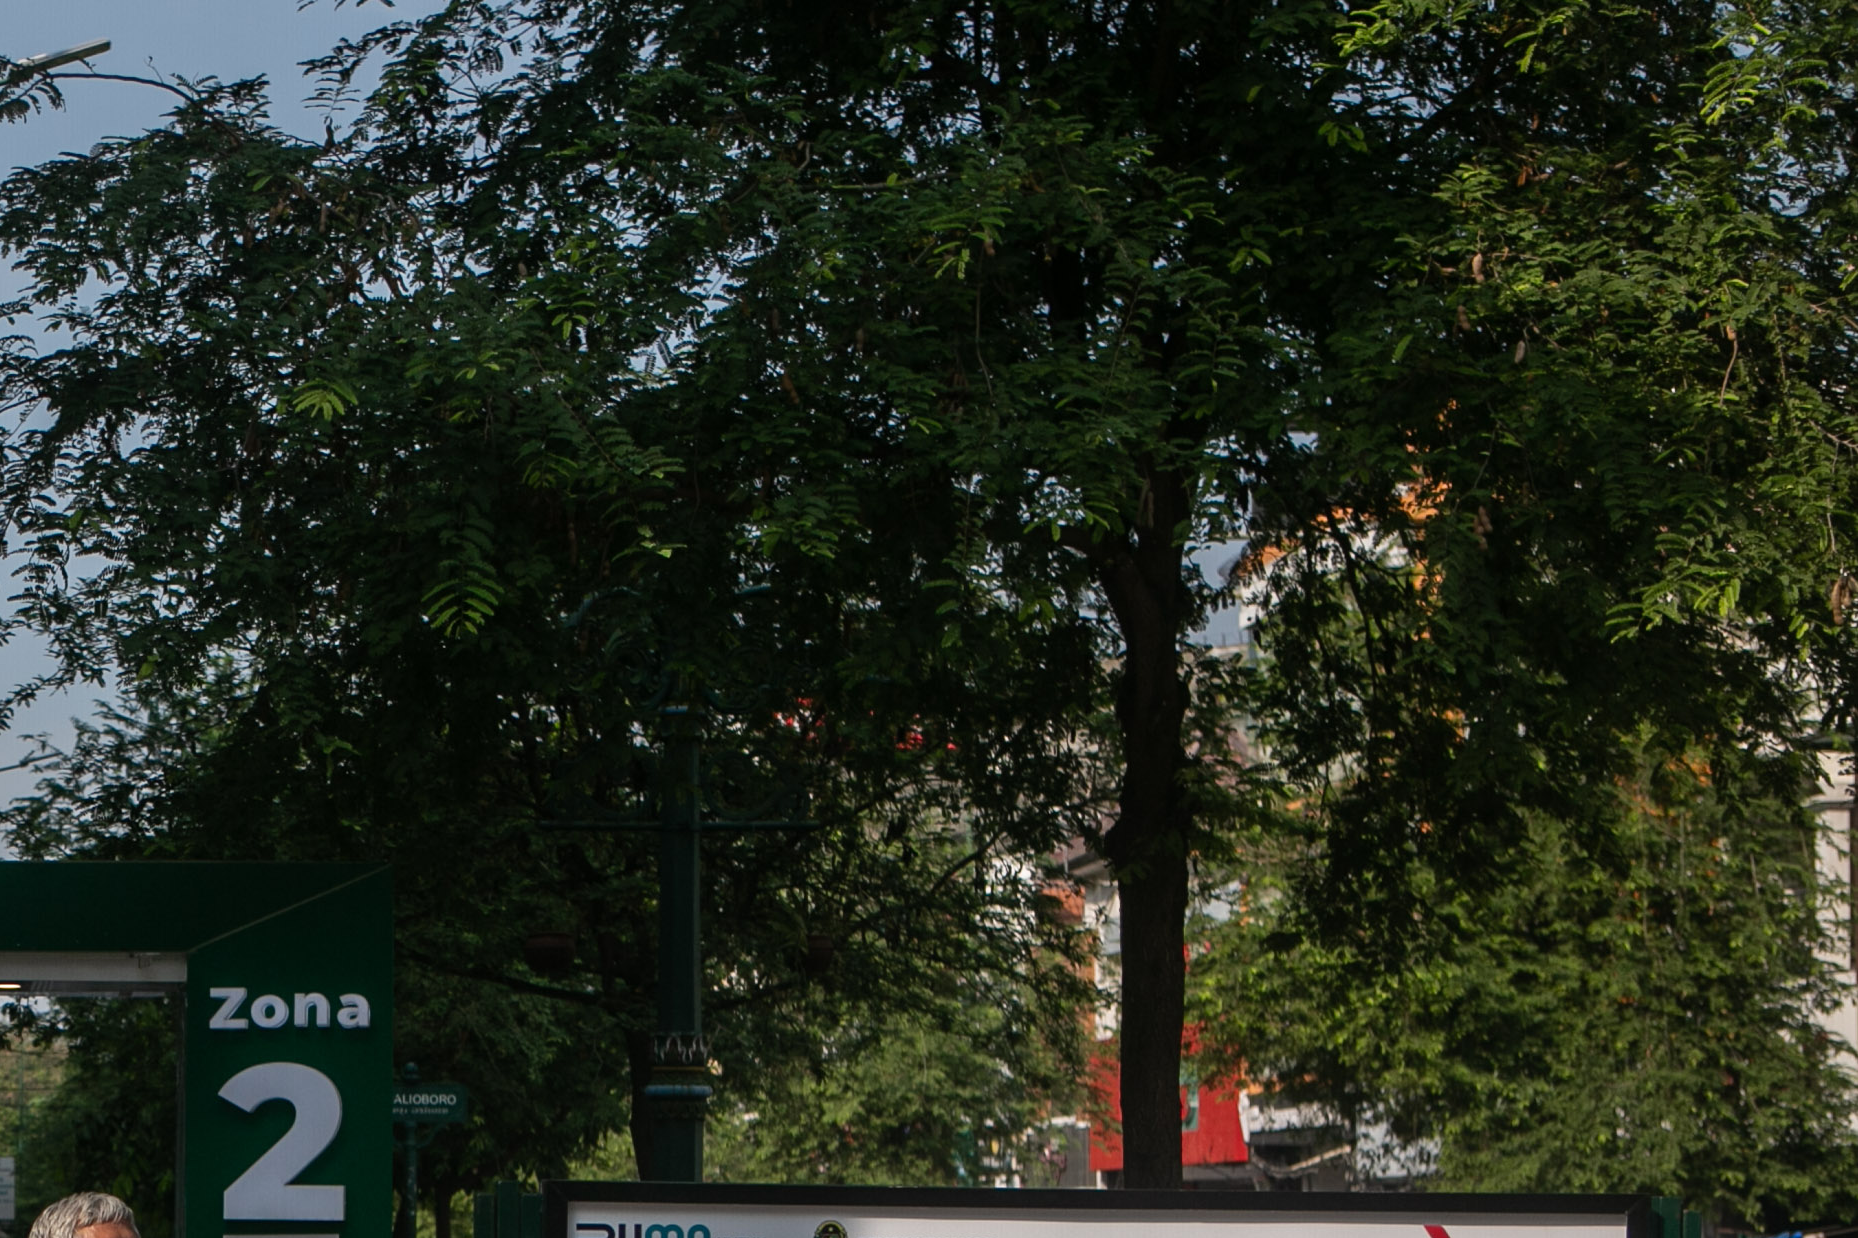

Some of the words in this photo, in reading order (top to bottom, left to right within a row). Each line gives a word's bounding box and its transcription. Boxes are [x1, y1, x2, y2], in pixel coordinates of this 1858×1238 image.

[209, 986, 371, 1029] Zona
[393, 1094, 457, 1105] ALIOBORO
[218, 1061, 346, 1223] 2
